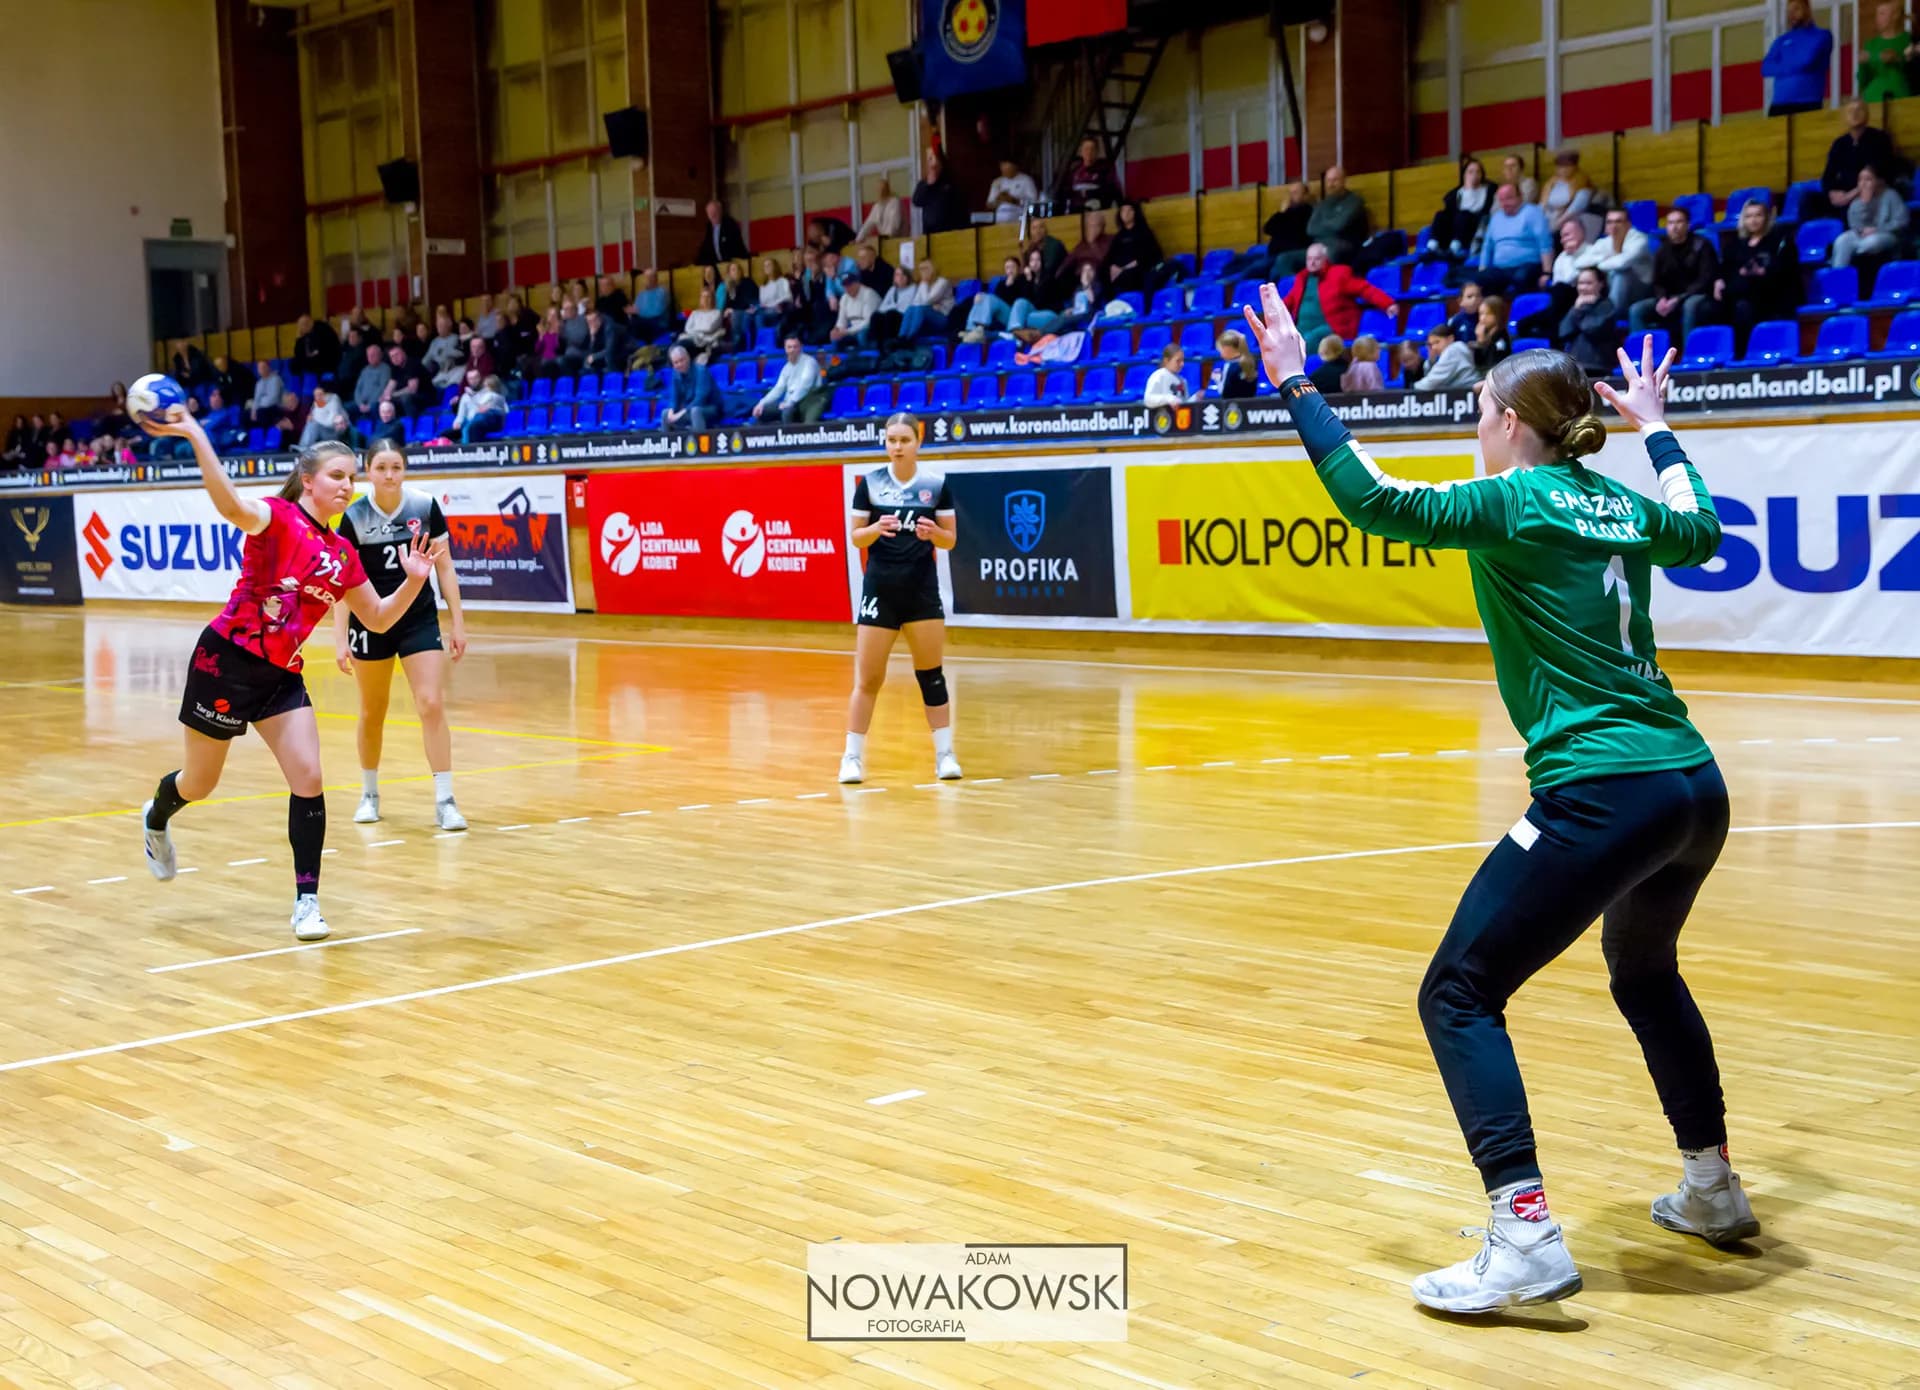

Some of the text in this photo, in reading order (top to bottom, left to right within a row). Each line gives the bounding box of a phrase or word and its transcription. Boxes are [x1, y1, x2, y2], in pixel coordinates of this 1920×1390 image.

[1601, 365, 1902, 407] koronahandball.pl
[1247, 391, 1475, 424] wwwnahandball.pl
[969, 409, 1150, 436] www.koronahandball.pl
[561, 435, 682, 458] www.koronahandball.pl
[640, 521, 665, 536] LIGA
[765, 520, 792, 536] LIGA
[641, 538, 701, 554] CENTRALNA
[766, 538, 836, 554] CENTRALNA
[314, 550, 343, 587] 32
[642, 555, 678, 570] KOBIET
[767, 556, 808, 572] KOBIET
[980, 558, 1079, 582] PROFIKA
[1602, 555, 1635, 657] 1
[349, 627, 369, 655] 21
